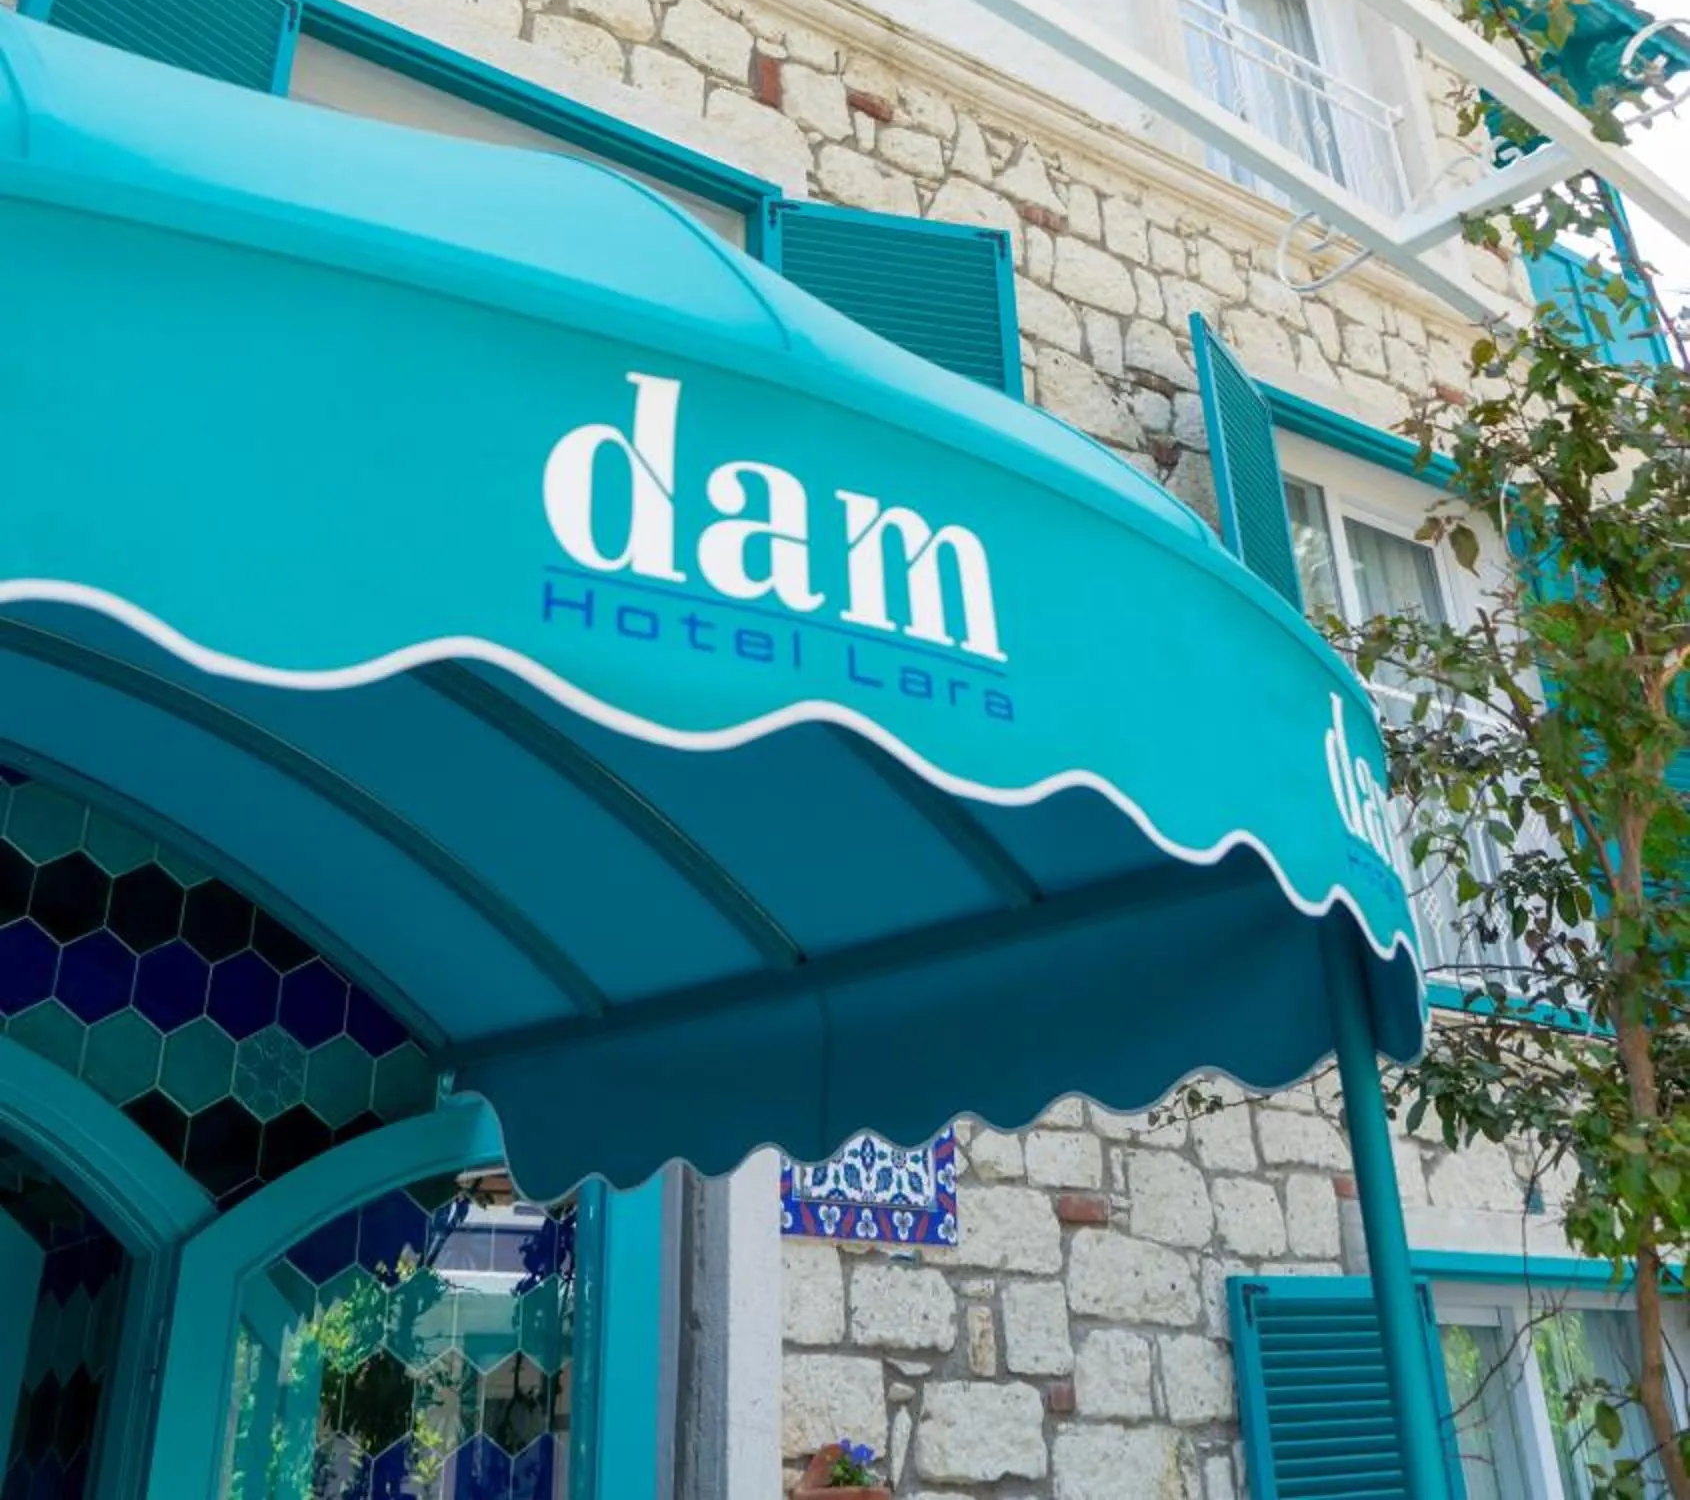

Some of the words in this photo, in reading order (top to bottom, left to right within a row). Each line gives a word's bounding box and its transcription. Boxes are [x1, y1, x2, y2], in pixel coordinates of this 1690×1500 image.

[542, 371, 1008, 663] dam
[543, 580, 801, 670] Hotel
[848, 645, 1015, 722] Lara
